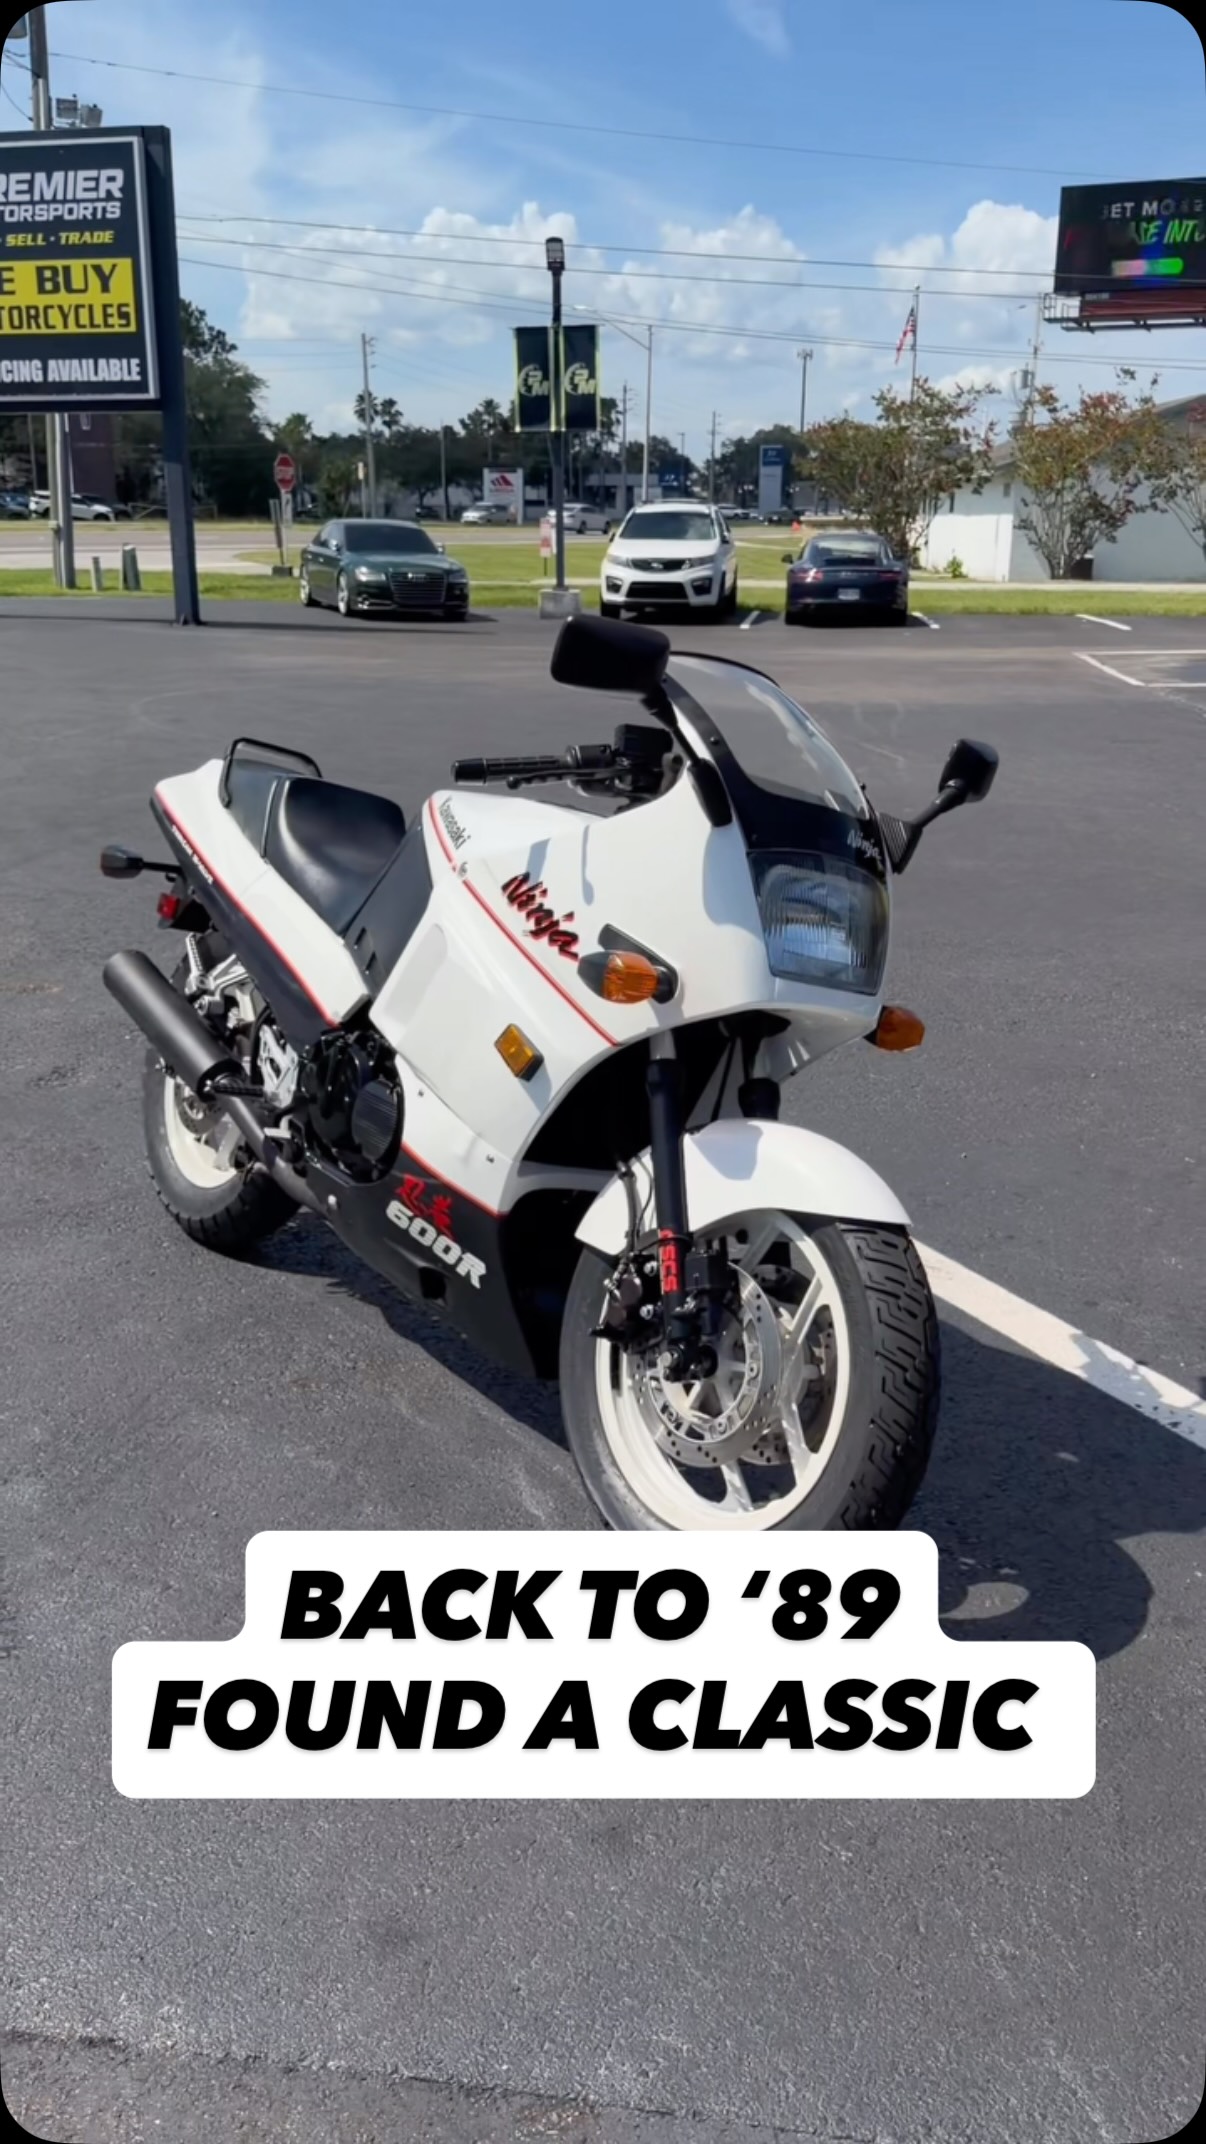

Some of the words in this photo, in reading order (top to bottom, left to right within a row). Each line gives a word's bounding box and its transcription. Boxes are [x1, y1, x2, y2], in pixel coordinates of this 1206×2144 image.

[1103, 201, 1135, 220] ET
[5, 232, 46, 247] SELL
[59, 230, 115, 245] TRADE
[35, 263, 118, 295] BUY
[48, 357, 141, 382] AVAILABLE
[439, 795, 471, 850] Kawasaki
[501, 871, 580, 963] Ninja
[385, 1199, 487, 1290] 600R
